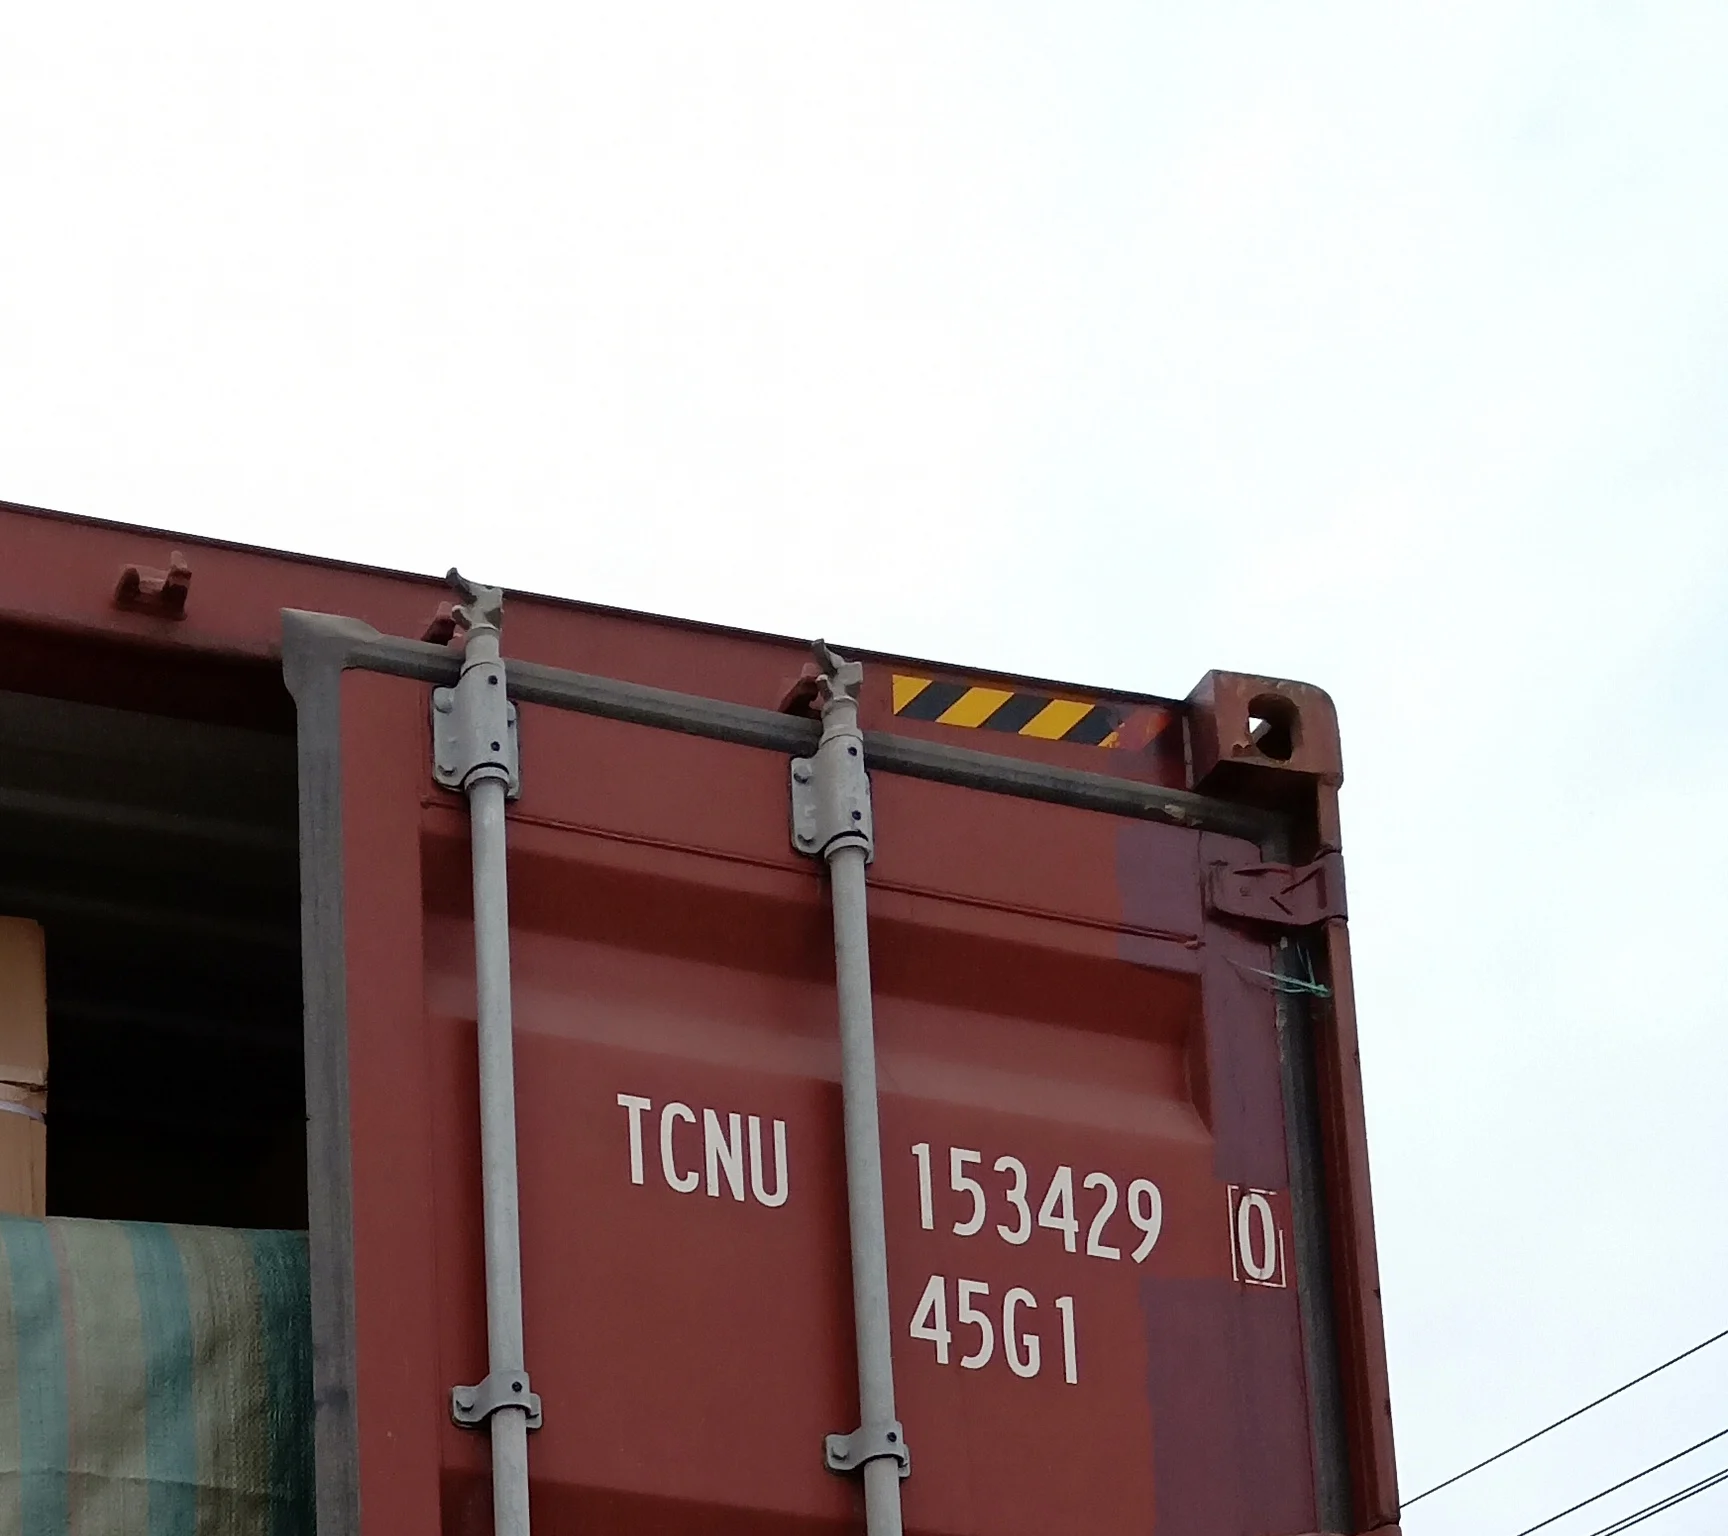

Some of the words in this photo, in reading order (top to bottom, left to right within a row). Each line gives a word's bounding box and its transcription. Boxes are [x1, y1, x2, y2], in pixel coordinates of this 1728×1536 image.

[617, 1094, 789, 1208] TCNU
[911, 1142, 1163, 1264] 153429
[909, 1275, 1079, 1385] 45G1
